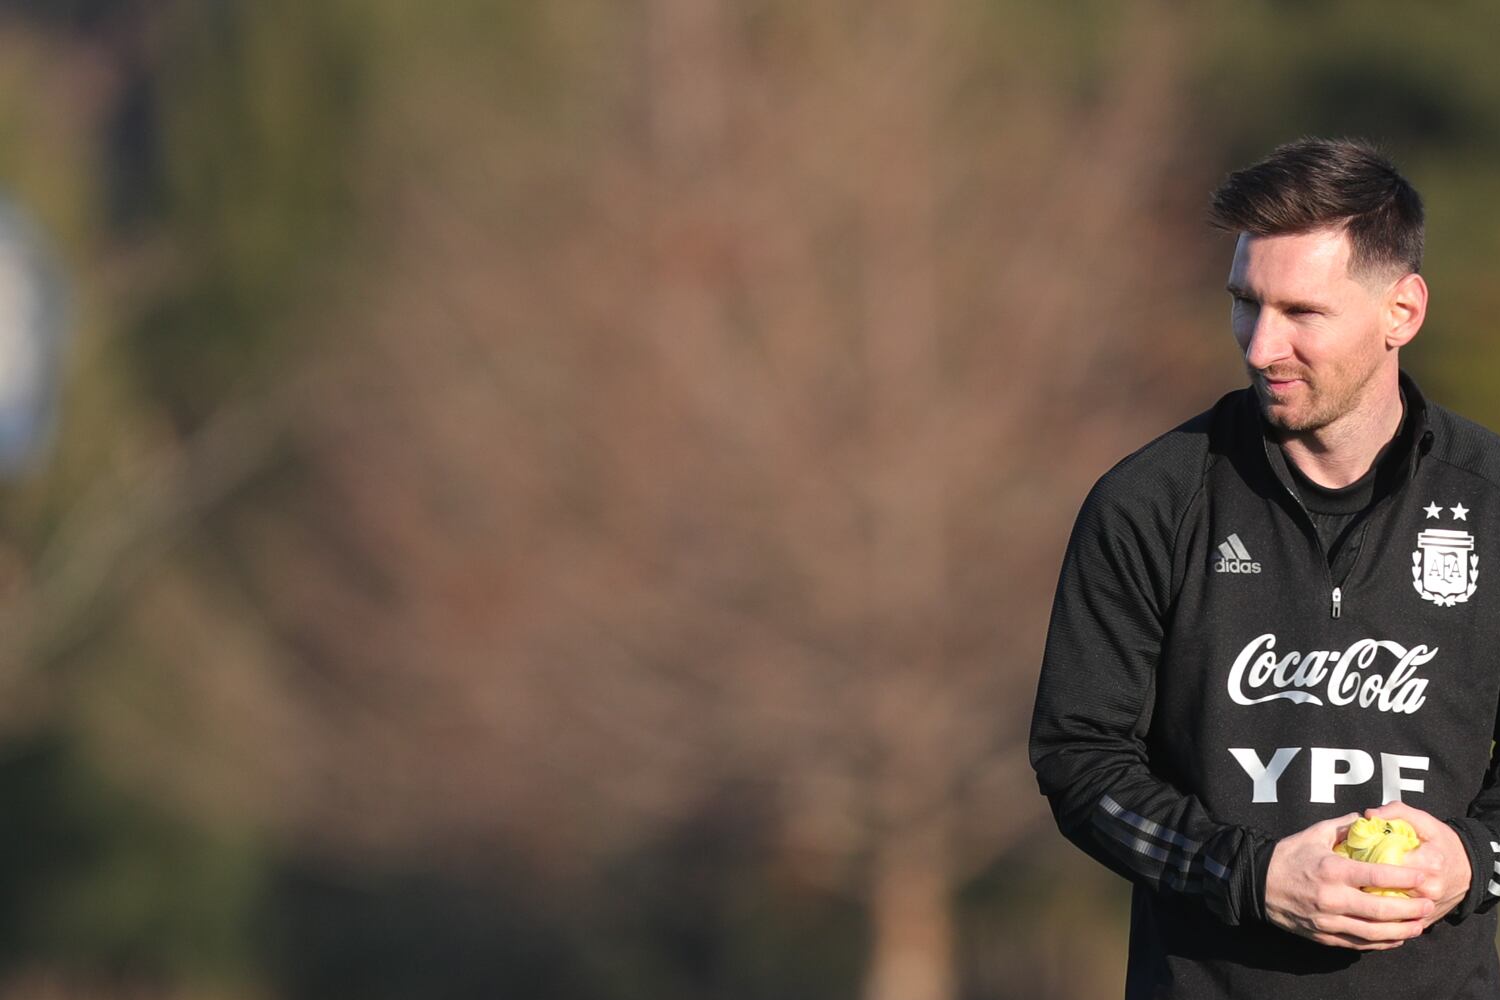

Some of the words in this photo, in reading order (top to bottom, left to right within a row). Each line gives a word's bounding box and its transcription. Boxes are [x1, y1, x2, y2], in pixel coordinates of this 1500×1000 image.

[1213, 557, 1262, 574] didas
[1428, 551, 1462, 584] AFA
[1227, 633, 1439, 715] Coca-Cola
[1227, 747, 1430, 805] YPF
